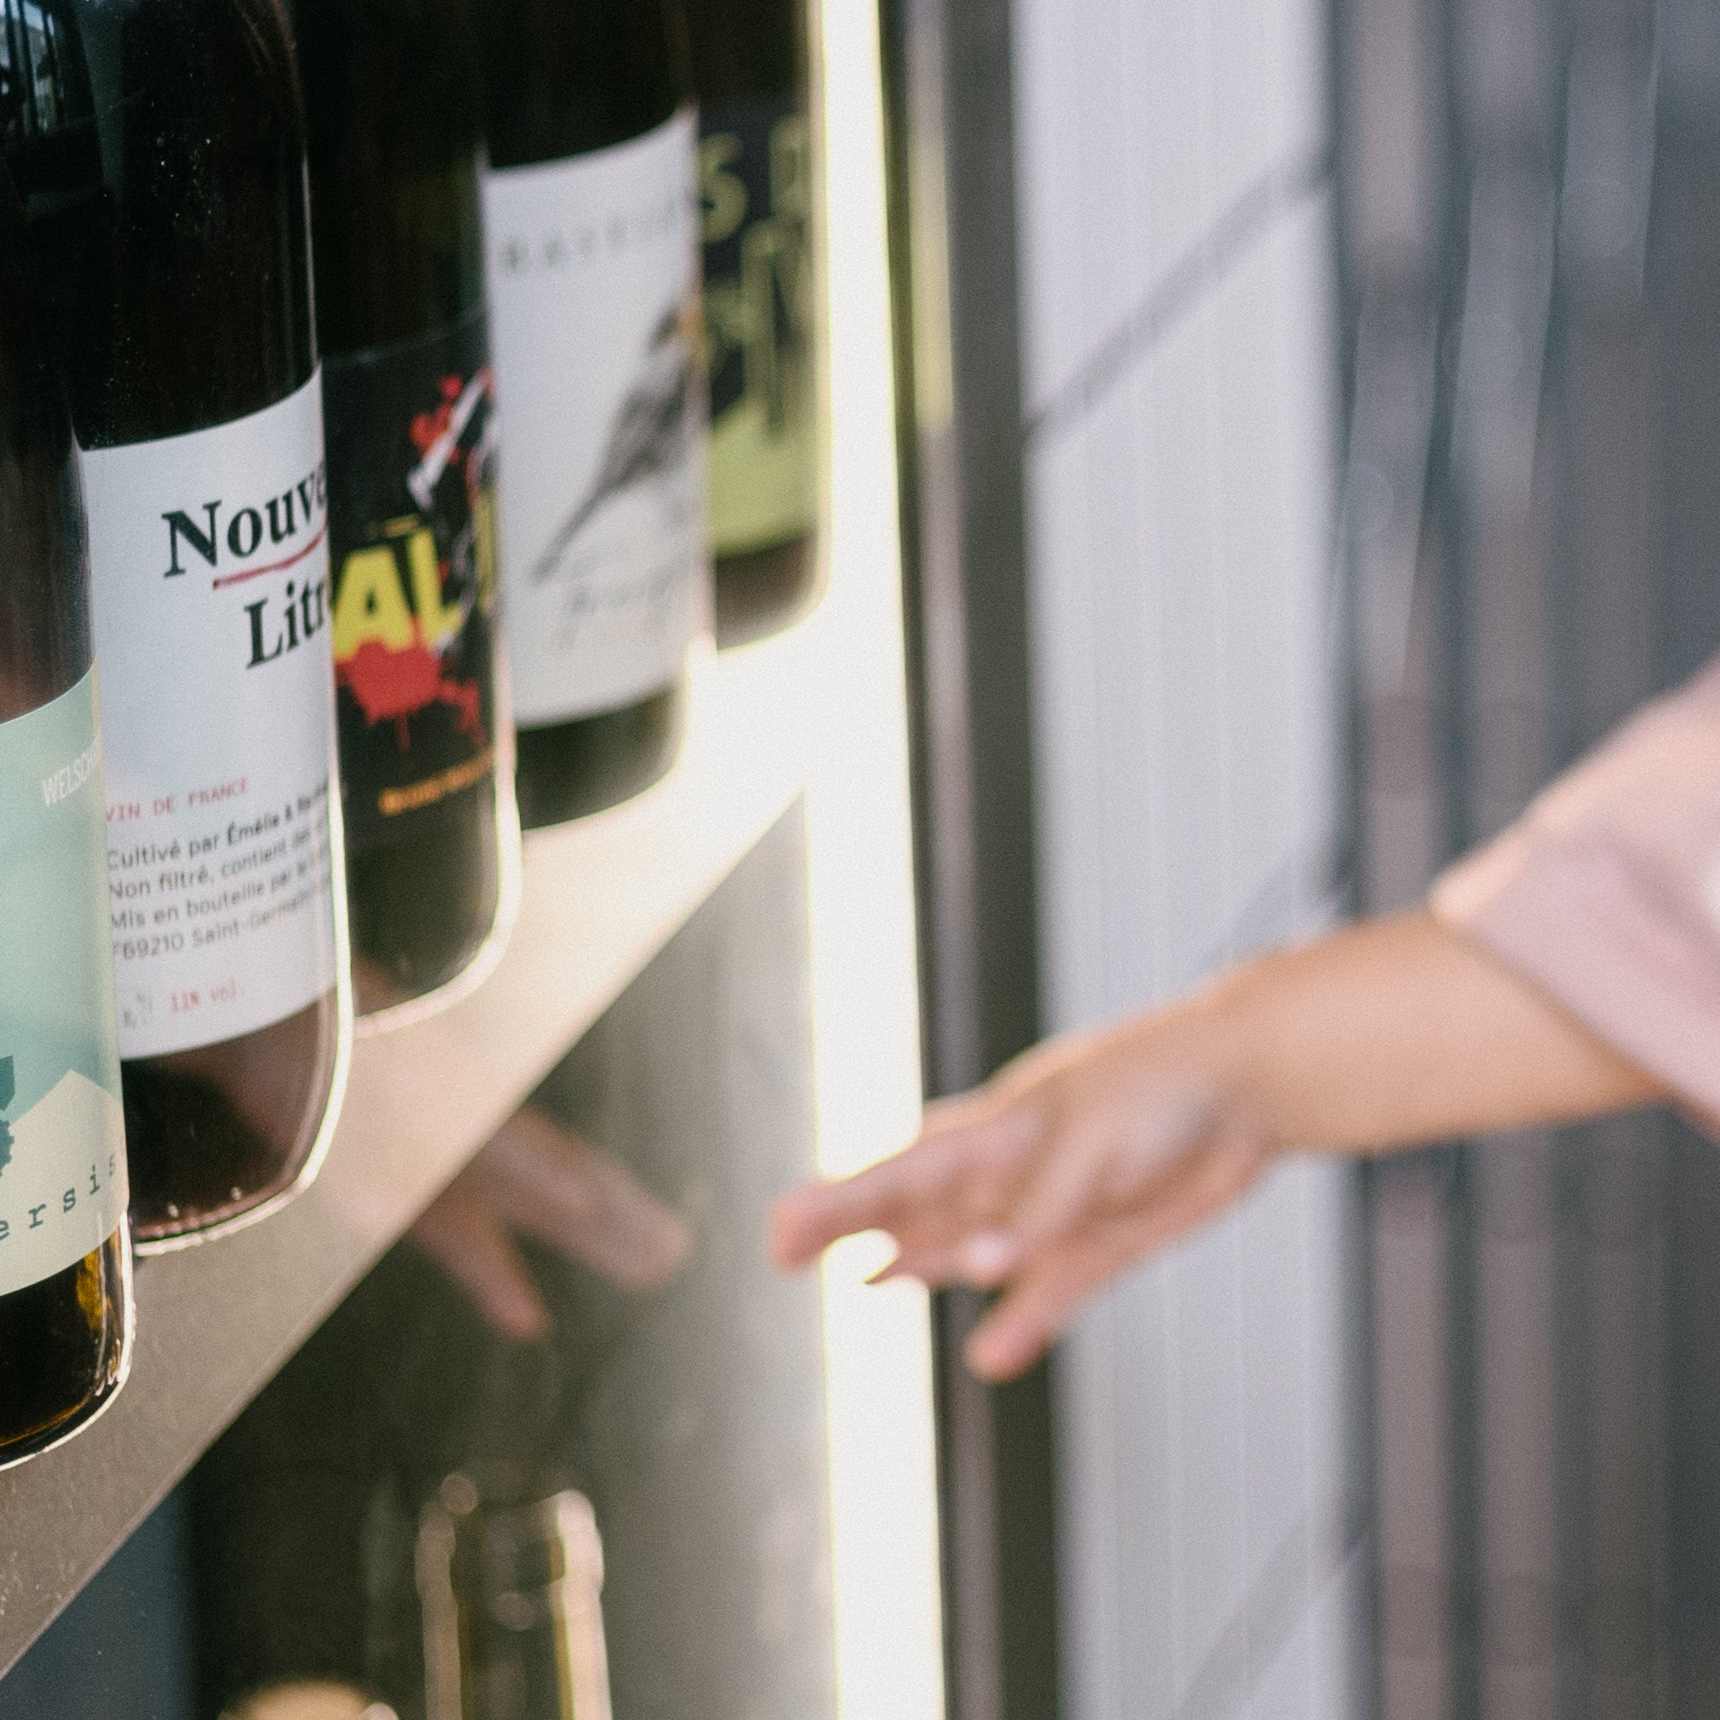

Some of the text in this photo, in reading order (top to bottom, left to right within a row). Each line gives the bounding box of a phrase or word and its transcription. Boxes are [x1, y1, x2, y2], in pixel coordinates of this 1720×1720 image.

[105, 777, 248, 822] VIN DE FRANCE
[108, 841, 181, 869] Cultivé
[189, 835, 220, 858] par
[109, 882, 151, 900] Non
[222, 838, 287, 877] contient
[111, 910, 146, 929] Mis
[153, 906, 179, 923] en
[186, 881, 265, 918] bouteille
